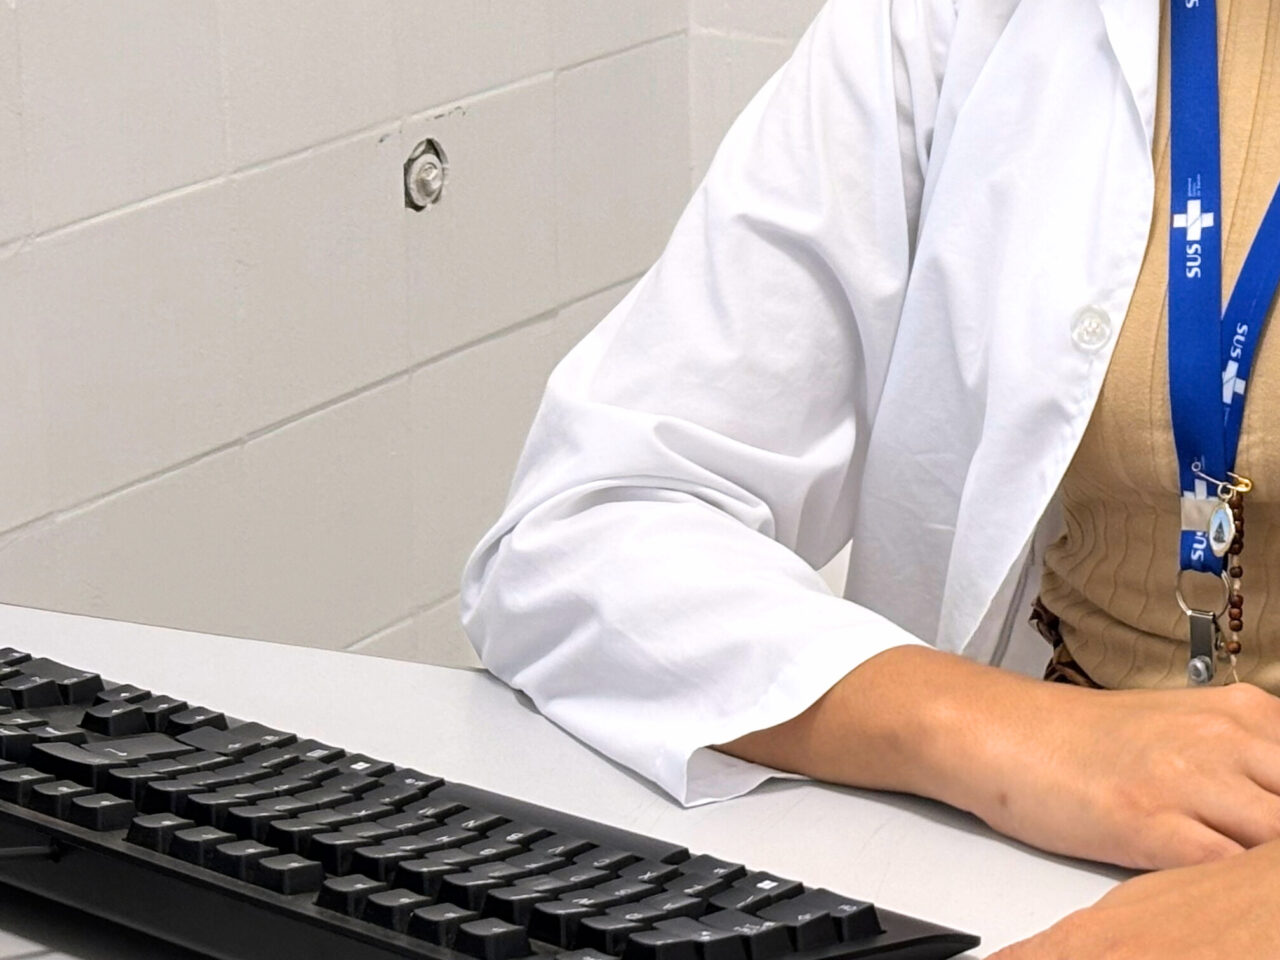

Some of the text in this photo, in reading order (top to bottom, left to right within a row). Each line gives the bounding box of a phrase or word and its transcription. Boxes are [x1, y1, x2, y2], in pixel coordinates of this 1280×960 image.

[1186, 243, 1202, 278] SUS
[1230, 322, 1248, 359] SUS
[1191, 531, 1208, 561] SU
